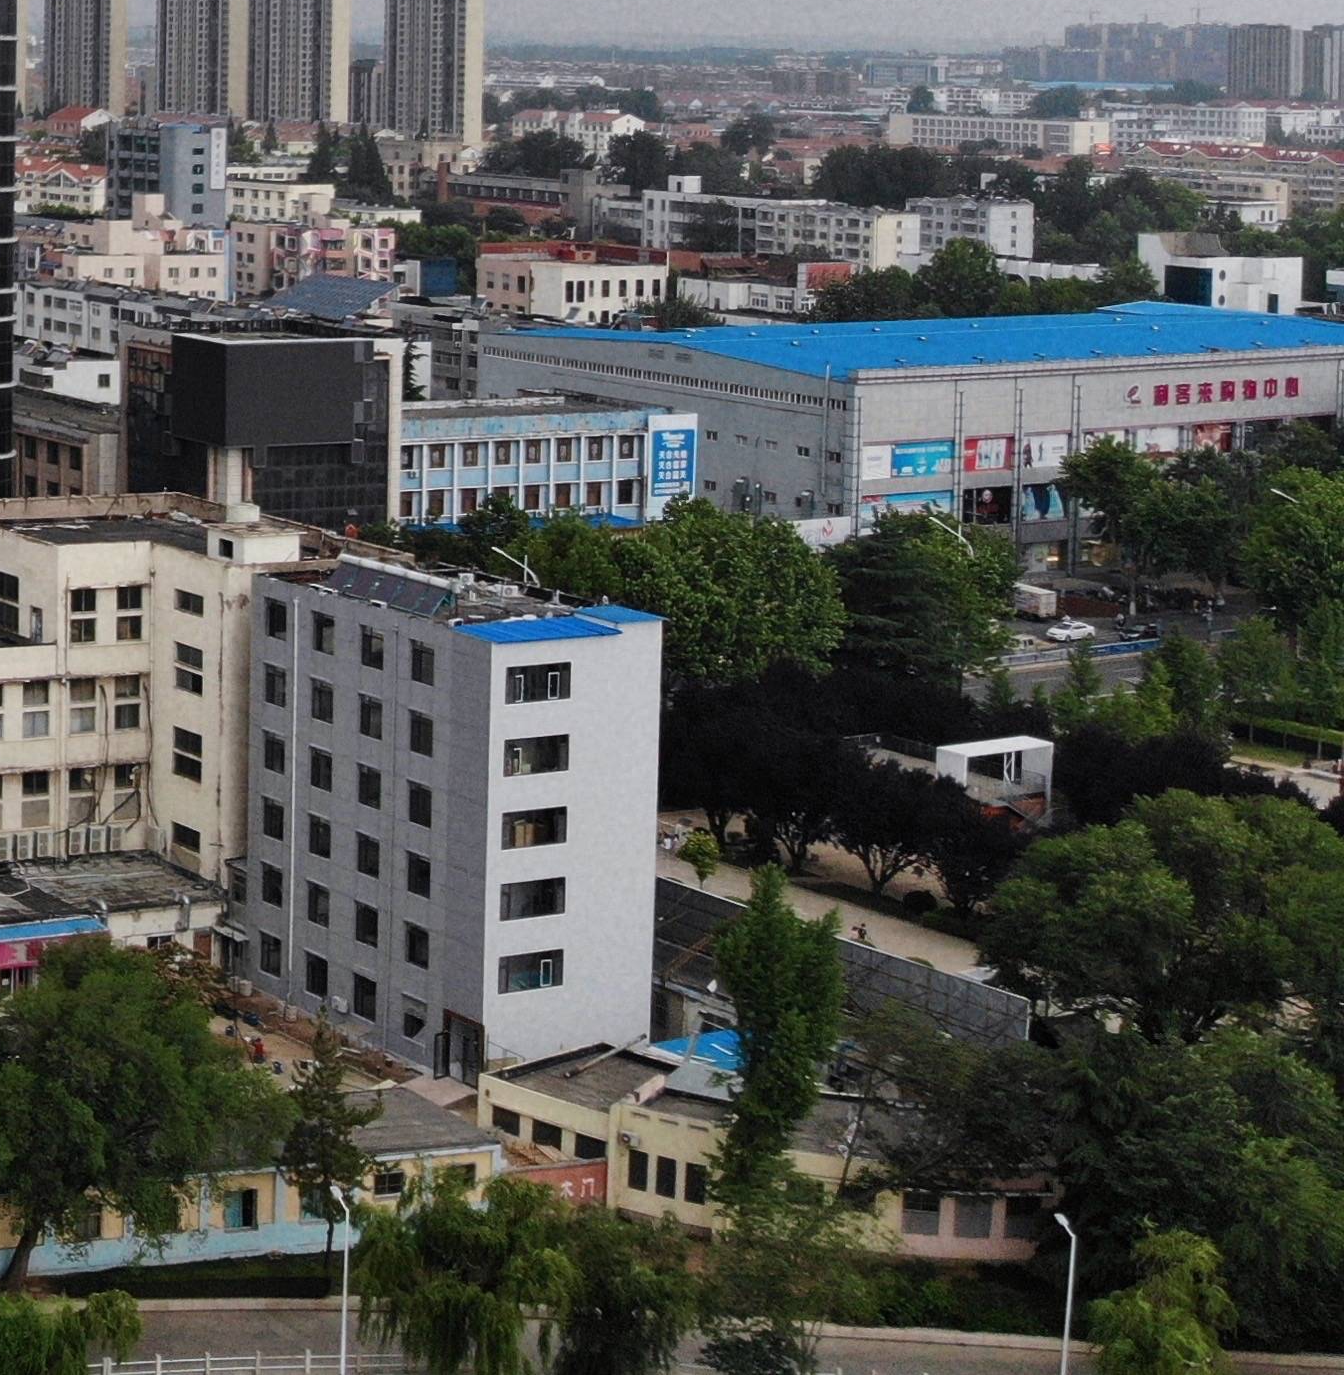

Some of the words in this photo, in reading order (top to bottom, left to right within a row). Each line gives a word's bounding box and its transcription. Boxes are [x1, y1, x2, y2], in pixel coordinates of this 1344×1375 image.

[1153, 377, 1299, 407] 利客来购物中心
